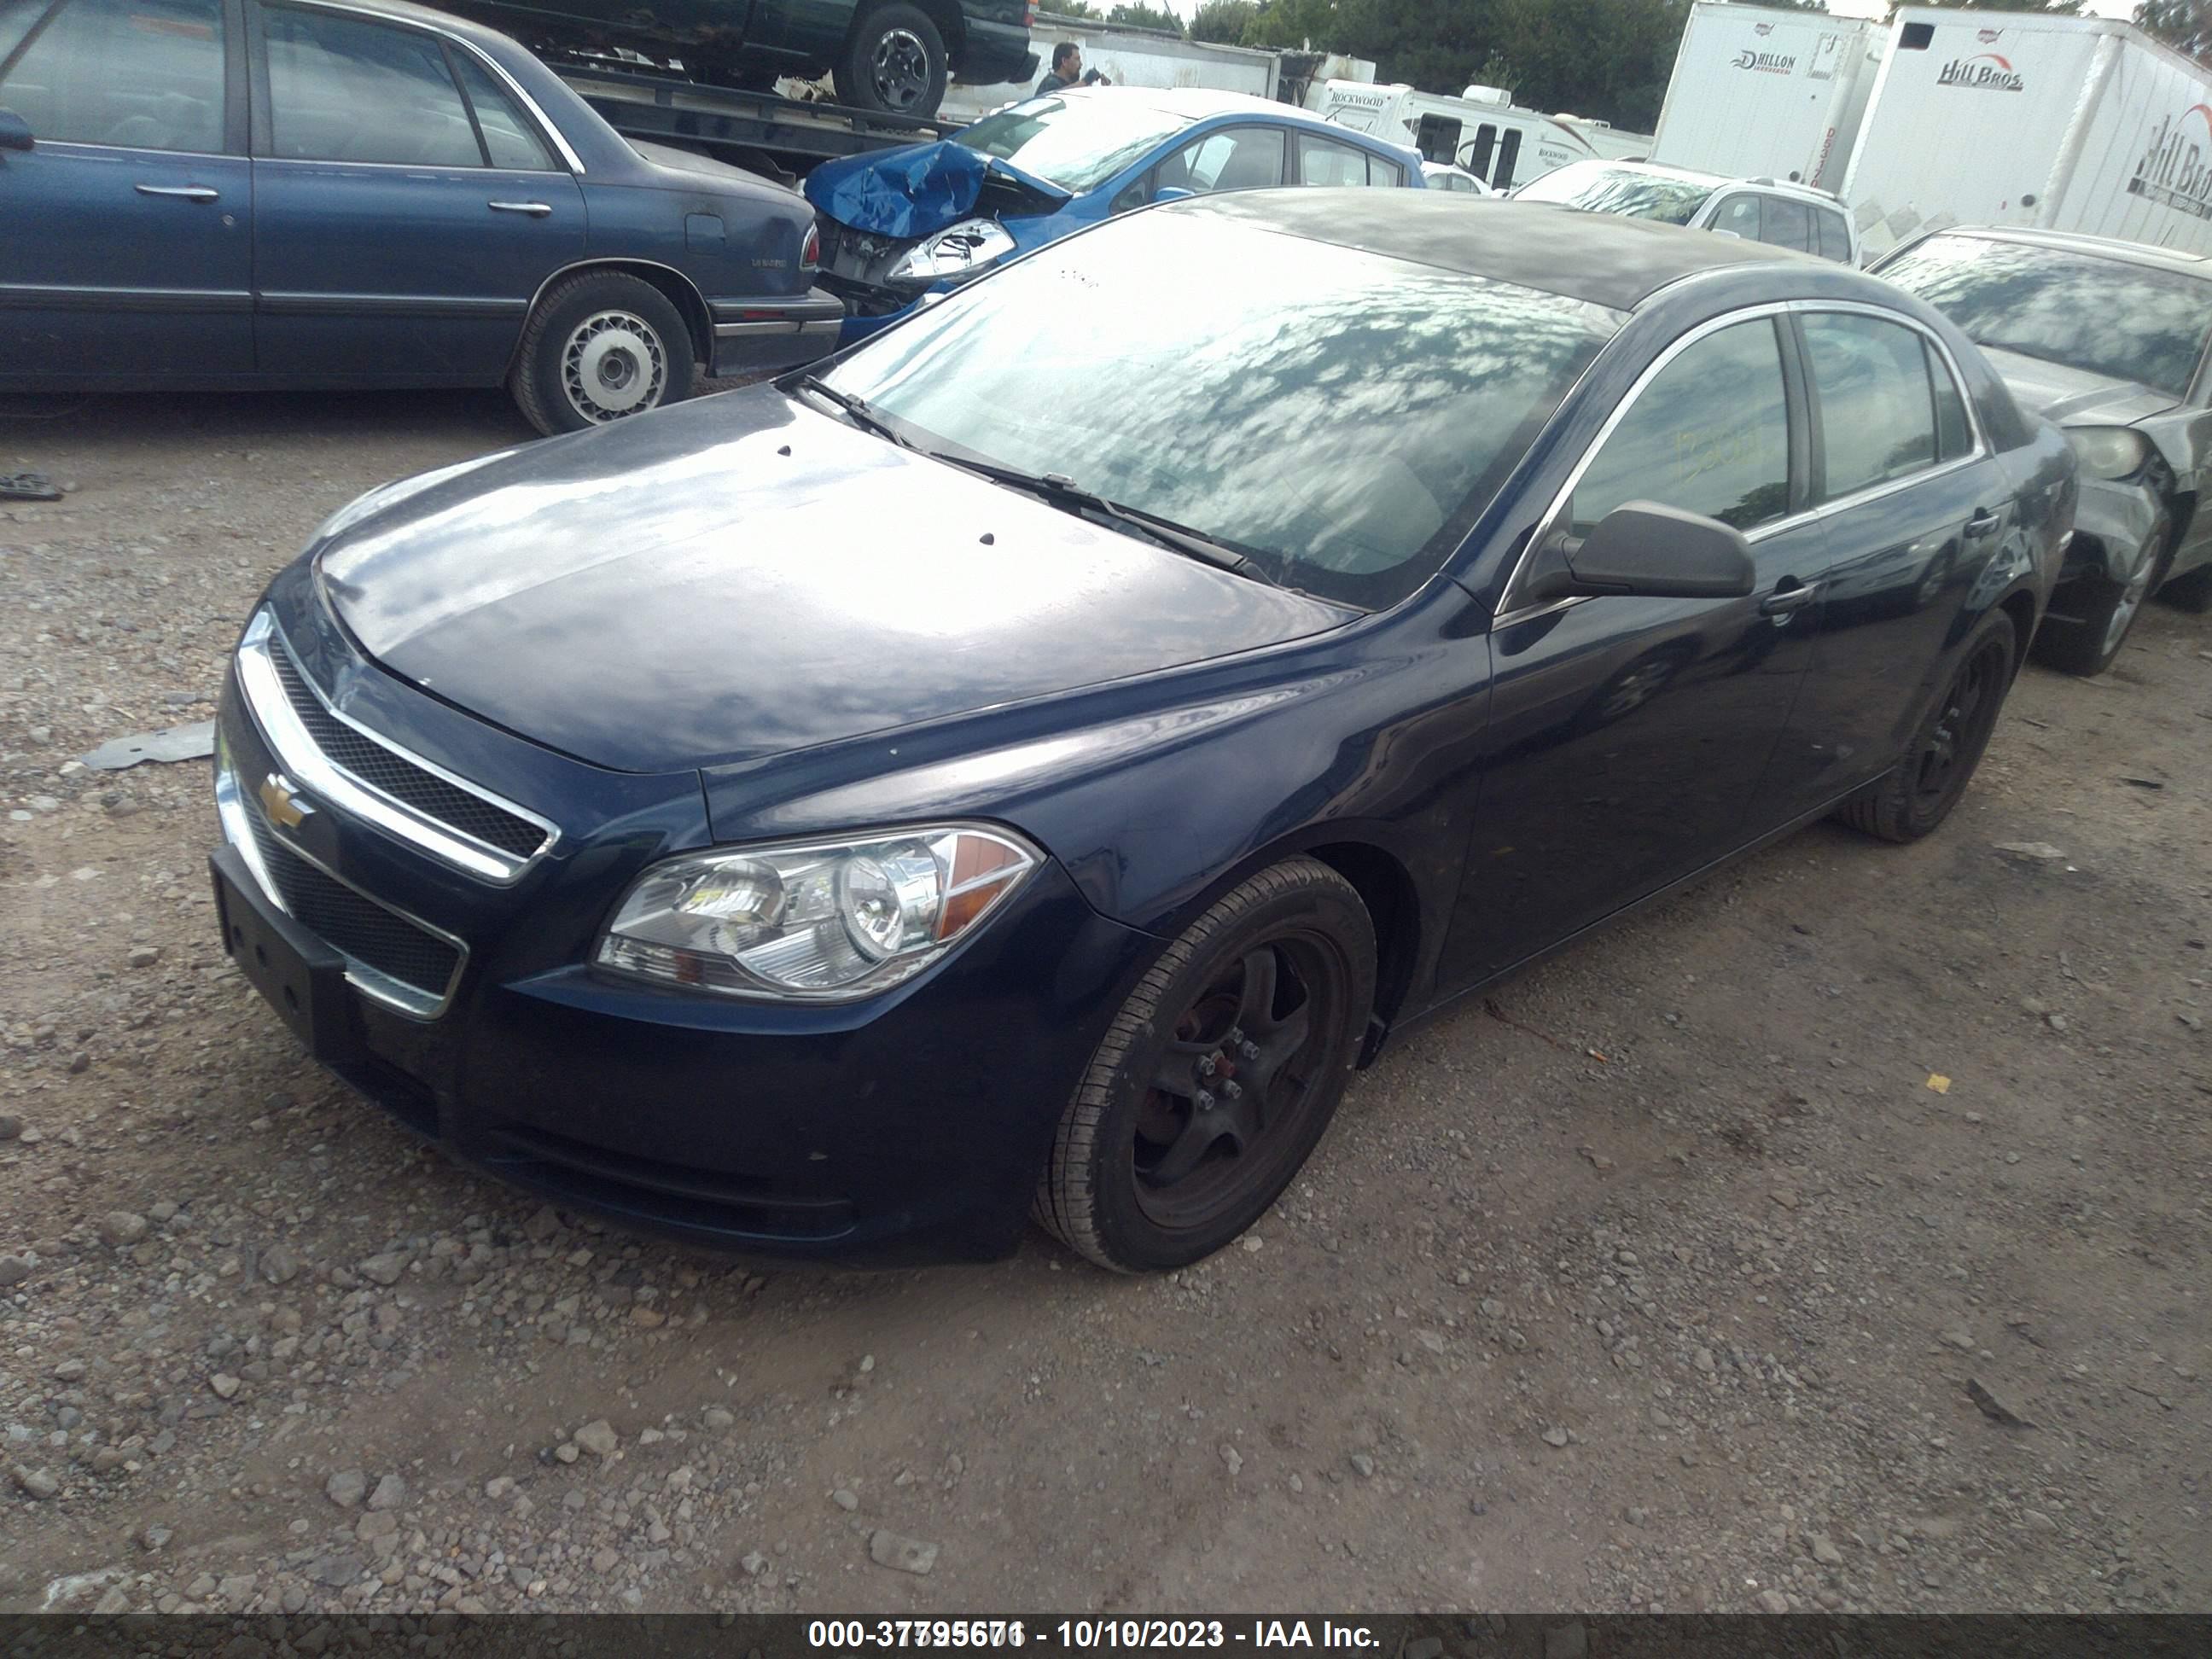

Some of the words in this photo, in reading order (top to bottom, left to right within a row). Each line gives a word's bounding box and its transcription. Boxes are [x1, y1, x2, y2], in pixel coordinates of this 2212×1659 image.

[1731, 49, 1796, 70] DHILLON
[1939, 59, 1976, 81] Hill
[1331, 92, 1383, 107] ROCKWOOD
[2135, 114, 2185, 187] Hill
